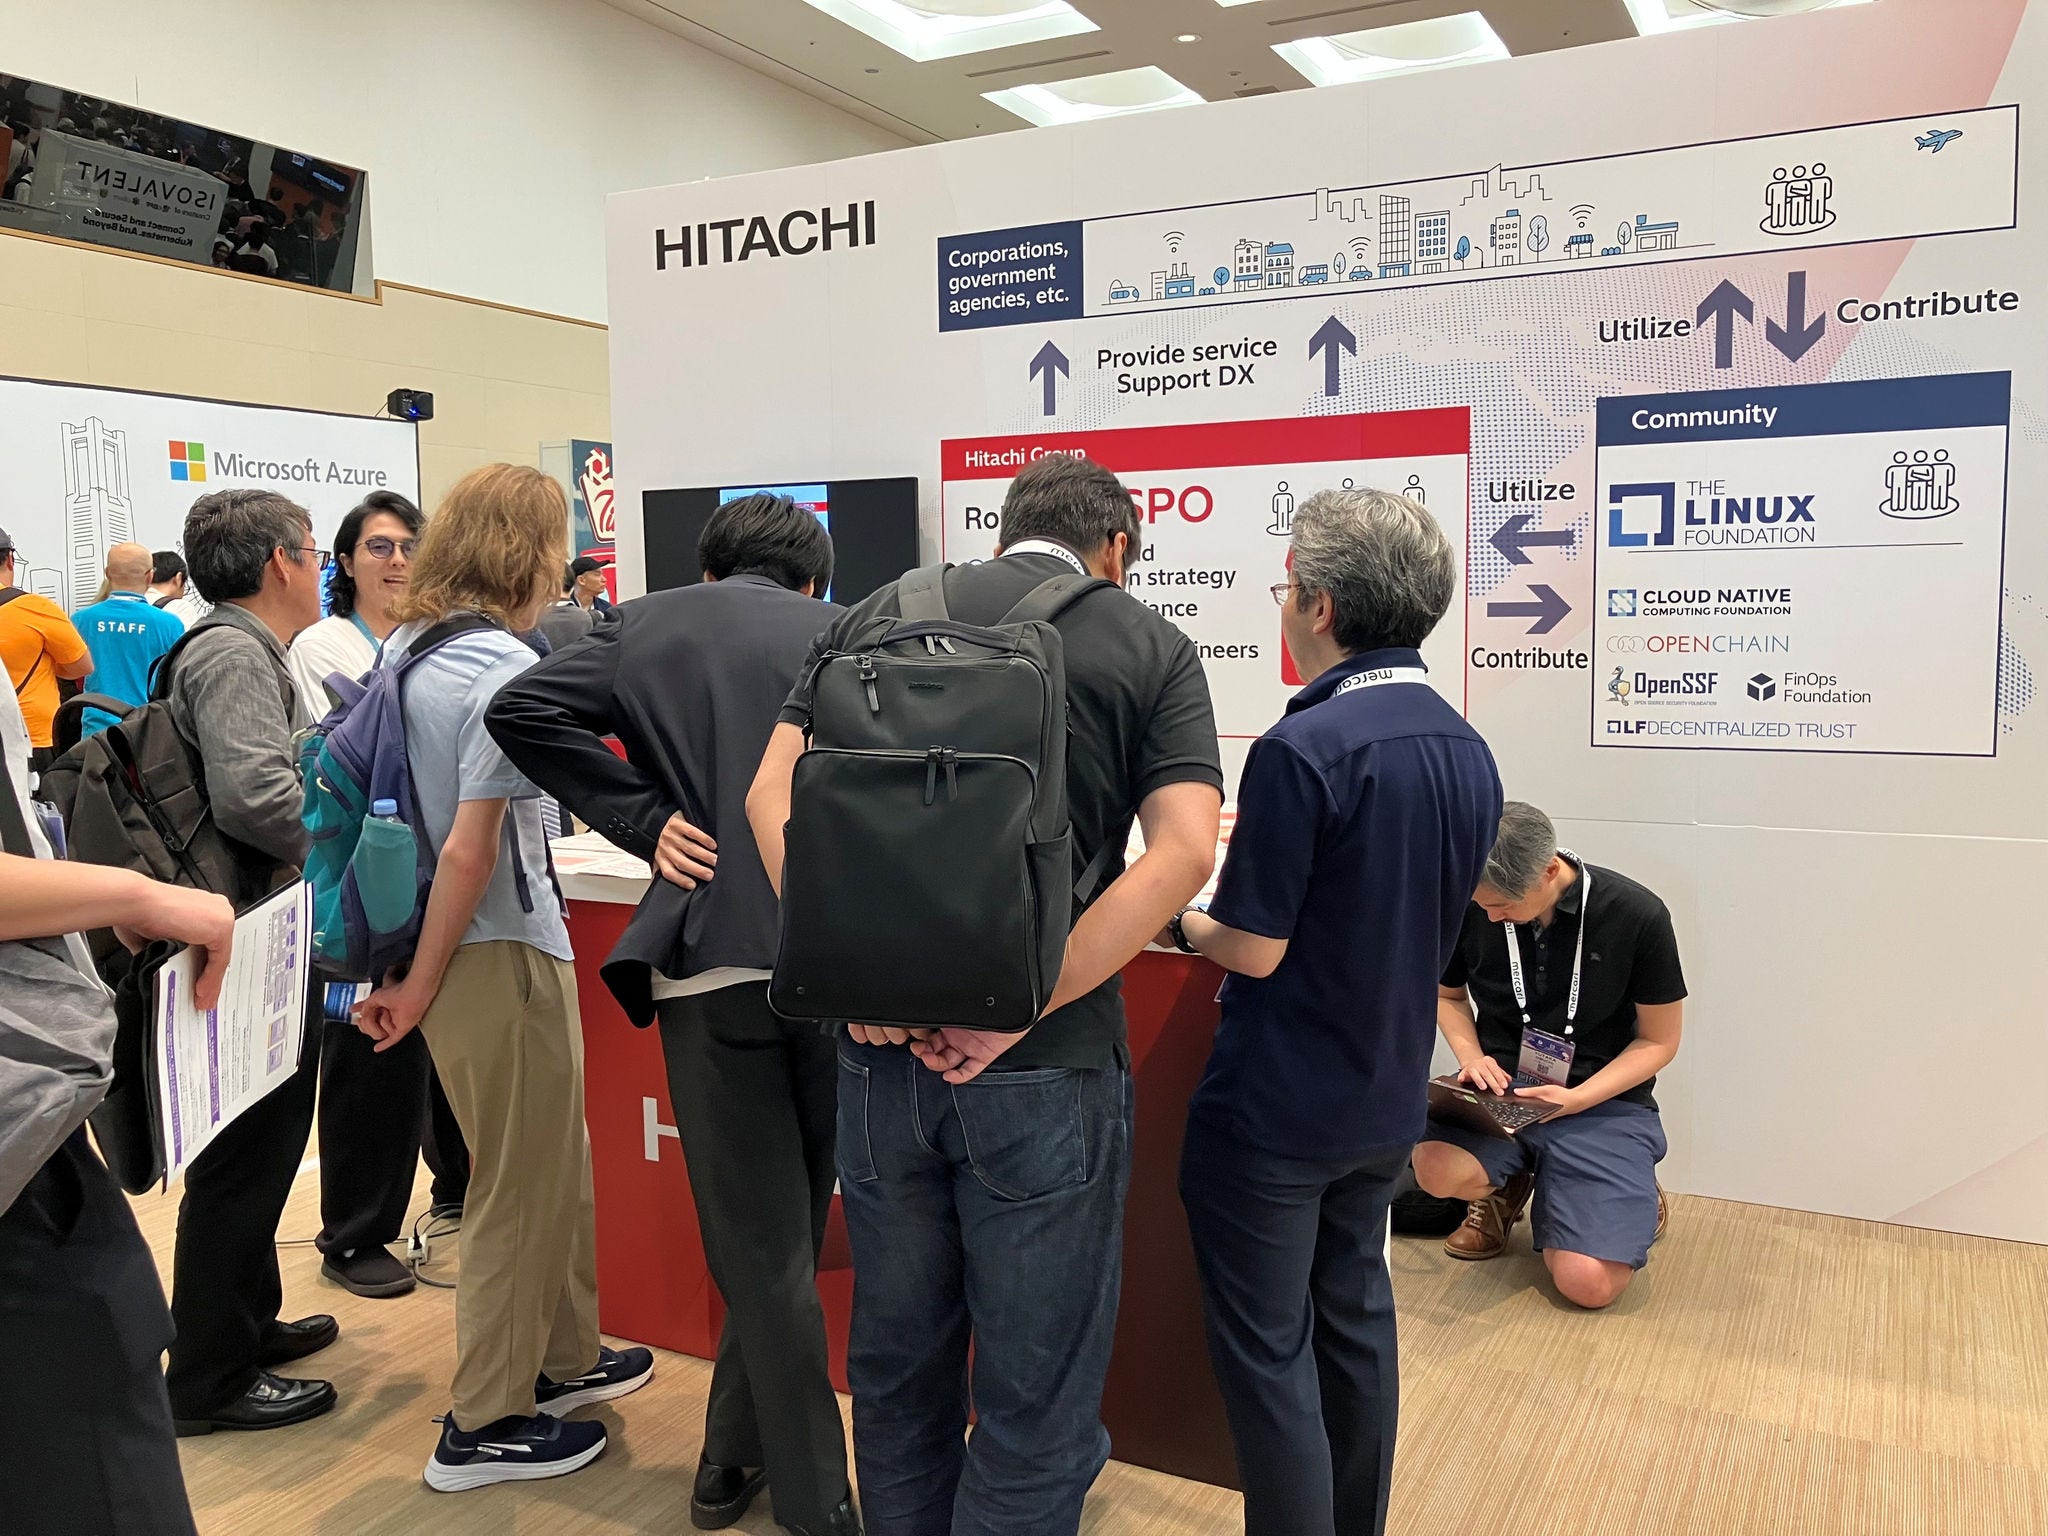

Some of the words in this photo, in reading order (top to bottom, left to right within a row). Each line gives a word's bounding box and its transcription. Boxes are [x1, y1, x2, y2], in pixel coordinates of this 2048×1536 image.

[655, 200, 875, 271] HITACHI
[948, 241, 1069, 269] Corporations,
[948, 263, 1056, 295] government
[949, 290, 1031, 317] agencies,
[1035, 286, 1070, 304] etc.
[1836, 288, 2020, 324] Contribute
[1599, 316, 1691, 343] Utilize
[1097, 344, 1185, 370] Provide
[1192, 336, 1278, 362] service
[1117, 368, 1211, 397] Support
[1218, 363, 1255, 387] DX
[1631, 403, 1778, 431] Community
[213, 451, 321, 483] Microsoft
[325, 461, 387, 487] Azure
[965, 447, 1025, 468] Hitachi
[1488, 479, 1576, 502] Utilize
[1686, 479, 1726, 496] THE
[1685, 494, 1816, 526] LINUX
[1684, 526, 1816, 546] FOUNDATION
[1147, 568, 1236, 589] strategy
[1642, 589, 1711, 605] CLOUD
[1718, 588, 1791, 604] NATIVE
[1642, 606, 1711, 617] COMPUTING
[1714, 605, 1791, 616] FOUNDATION
[97, 620, 146, 635] STAFF
[1646, 635, 1790, 654] OPENCHAIN
[1470, 646, 1589, 670] Contribute
[1634, 672, 1719, 698] OpenSSF
[1784, 672, 1837, 687] FinOps
[1784, 689, 1872, 704] Foundation
[1795, 722, 1857, 739] TRUST
[1512, 961, 1525, 1000] mercari
[1569, 972, 1579, 1013] mercari
